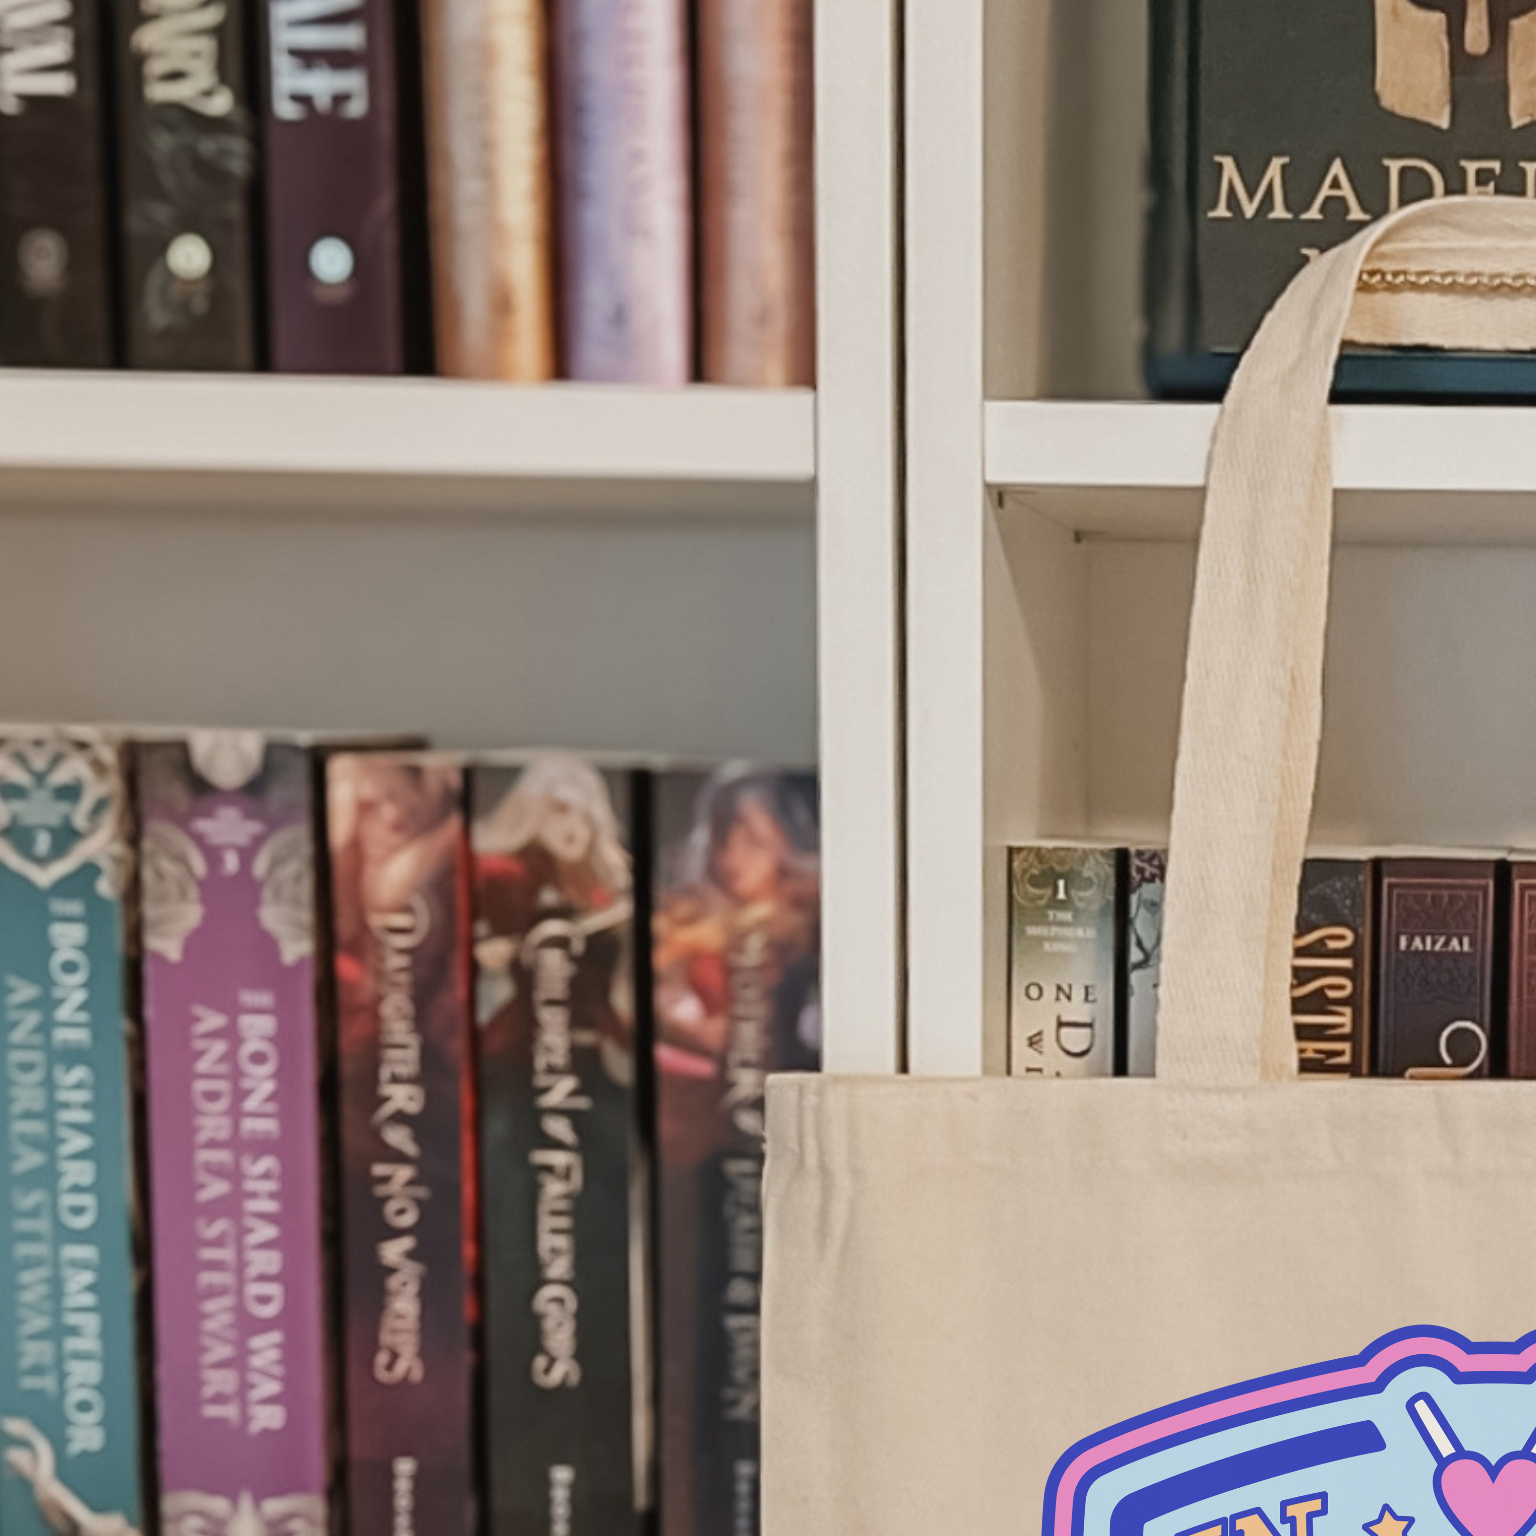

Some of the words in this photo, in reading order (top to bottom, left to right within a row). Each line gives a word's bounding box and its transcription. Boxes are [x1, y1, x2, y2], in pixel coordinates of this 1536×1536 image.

[47, 920, 92, 1049] BONE
[1025, 983, 1097, 1002] ONE
[1292, 926, 1355, 1079] SISTE
[1400, 935, 1473, 953] FAIZAL
[4, 975, 50, 1173] ANDREA
[54, 1063, 98, 1229] SHARD
[190, 1004, 235, 1203] ANDREA
[236, 1013, 280, 1139] BONE
[12, 1187, 57, 1398] STEWART
[240, 1154, 283, 1317] SHARD
[60, 1243, 105, 1456] EMPEROR
[195, 1218, 241, 1427] STEWART
[245, 1331, 287, 1437] WAR
